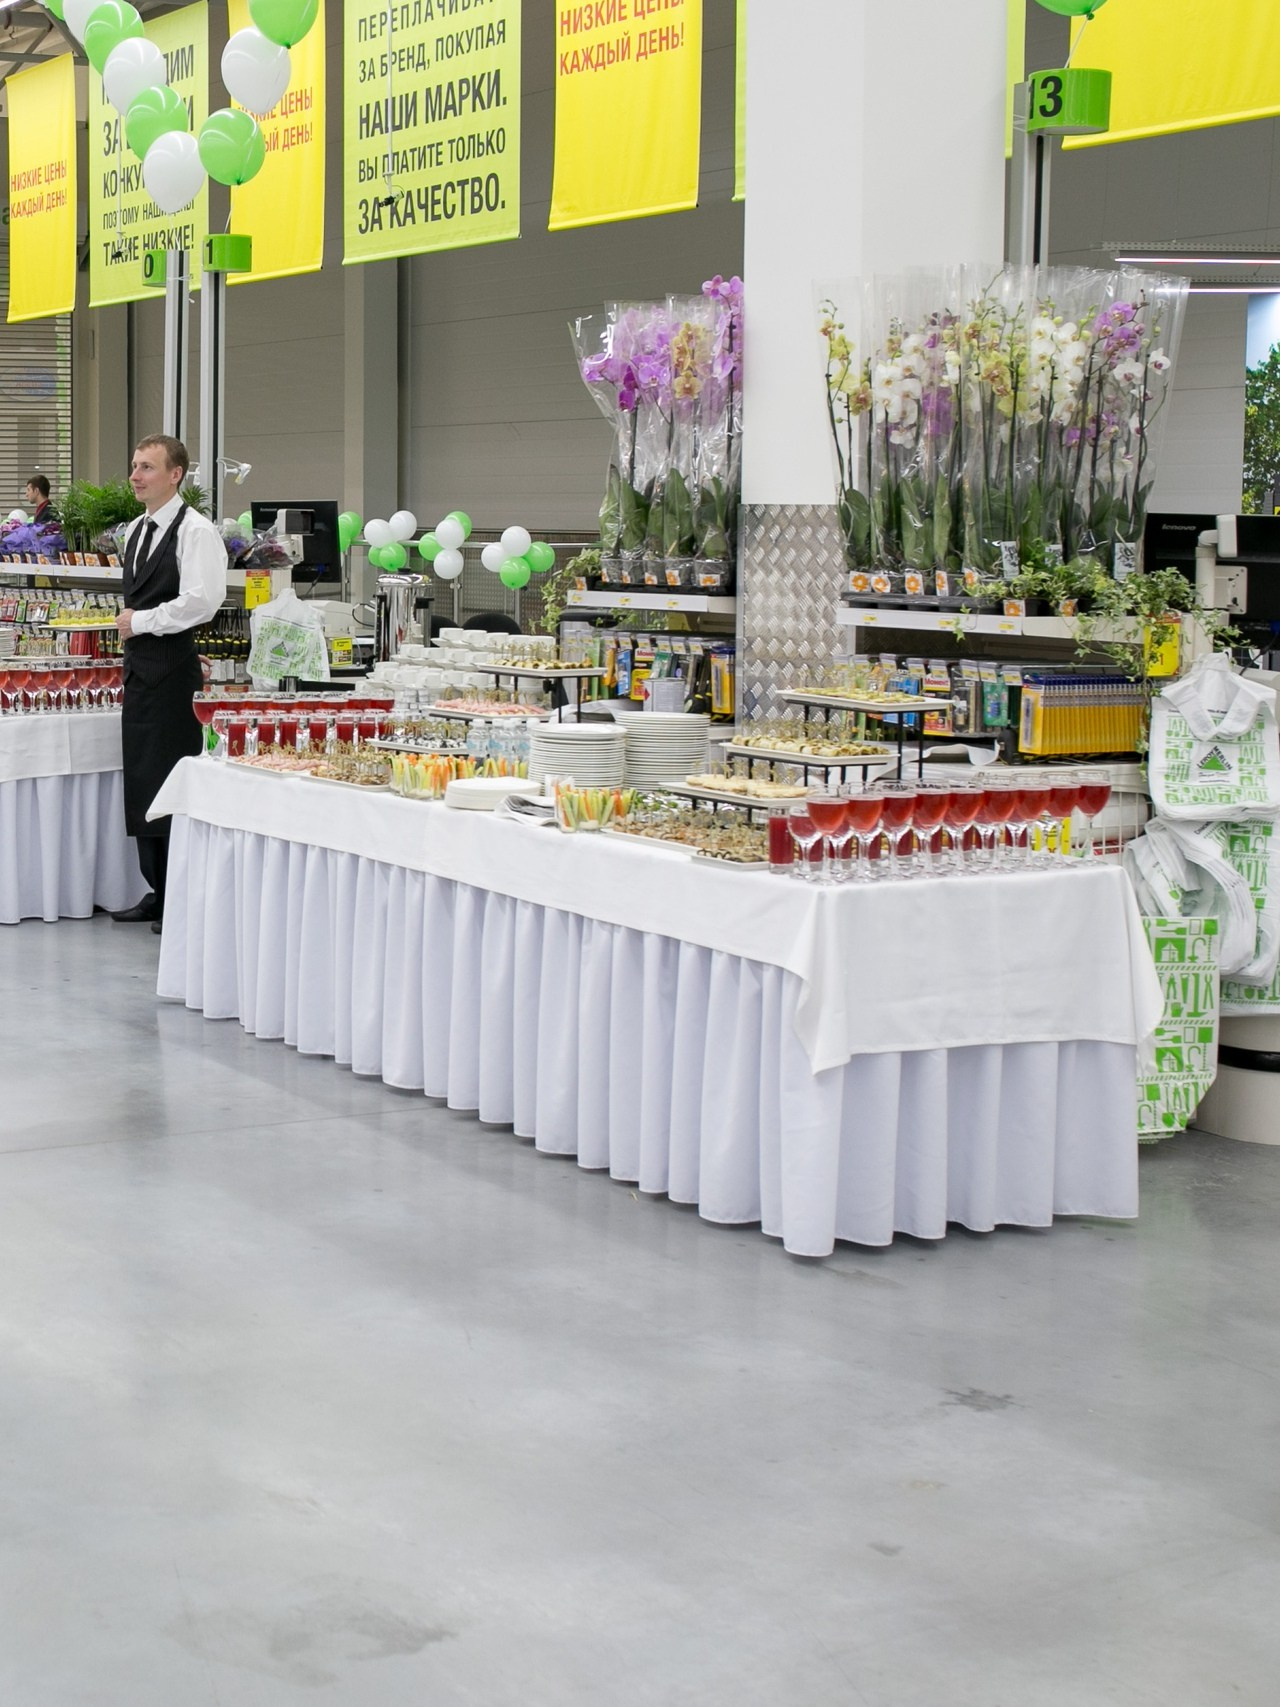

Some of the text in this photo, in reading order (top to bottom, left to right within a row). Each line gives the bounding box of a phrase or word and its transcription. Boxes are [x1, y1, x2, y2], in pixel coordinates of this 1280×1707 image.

[358, 0, 494, 43] ПЕРЕПЛАЧИ
[560, 0, 628, 37] НИЗКИЕ
[359, 19, 506, 83] ЗА БРЕНД, ПОКУПАЯ
[560, 22, 684, 76] КАЖДЫЙ ДЕНЬ!
[280, 86, 313, 119] ЦЕНЫ
[359, 69, 507, 140] НАШИ МАРКИ.
[282, 121, 313, 152] ДЕНЬ!
[359, 127, 506, 183] ВЫ ПЛАТИТЕ ТОЛЬКО
[10, 159, 67, 194] НИЗКИЕ ЦЕНЫ
[10, 191, 44, 220] КАЖДЫЙ
[45, 188, 68, 213] ДЕНЬ!
[358, 172, 506, 234] ЗА КАЧЕСТВО.
[103, 223, 195, 267] ТАКИЕ НИЗКИЕ!
[1161, 523, 1197, 531] lenovo
[1196, 745, 1233, 770] LEROY MERLIN
